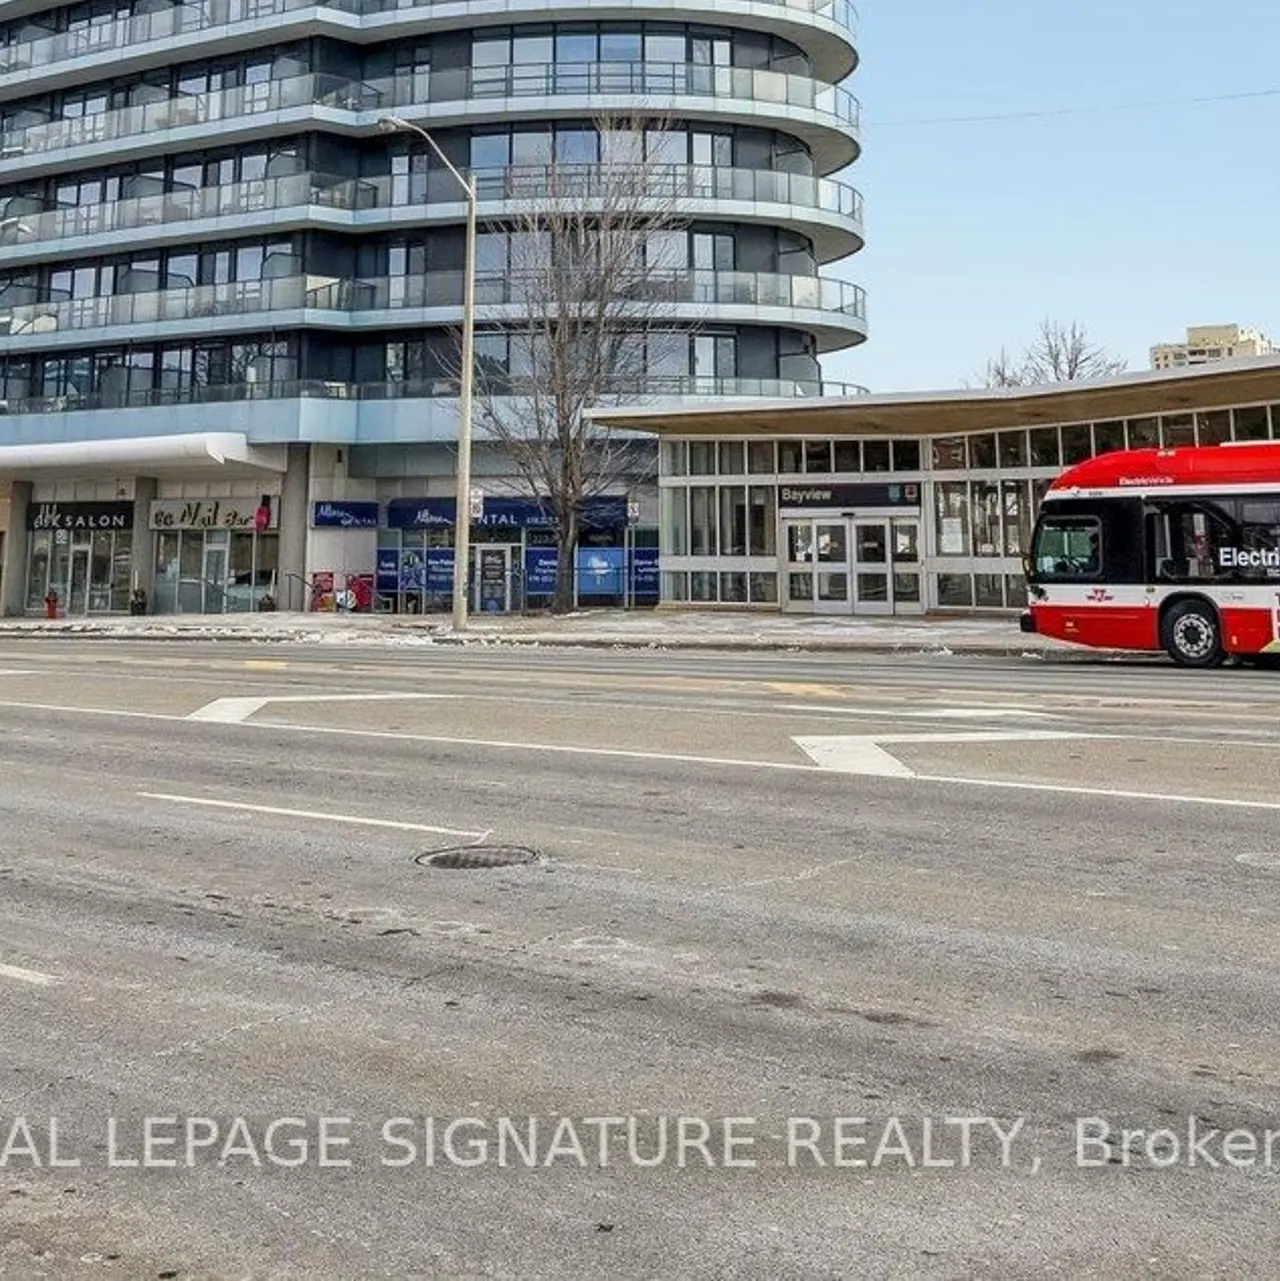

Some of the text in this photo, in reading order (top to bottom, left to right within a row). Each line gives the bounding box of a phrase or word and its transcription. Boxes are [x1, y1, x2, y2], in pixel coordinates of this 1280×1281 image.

[781, 487, 832, 503] Bayview
[64, 515, 125, 528] SALON
[478, 514, 518, 525] NTAL
